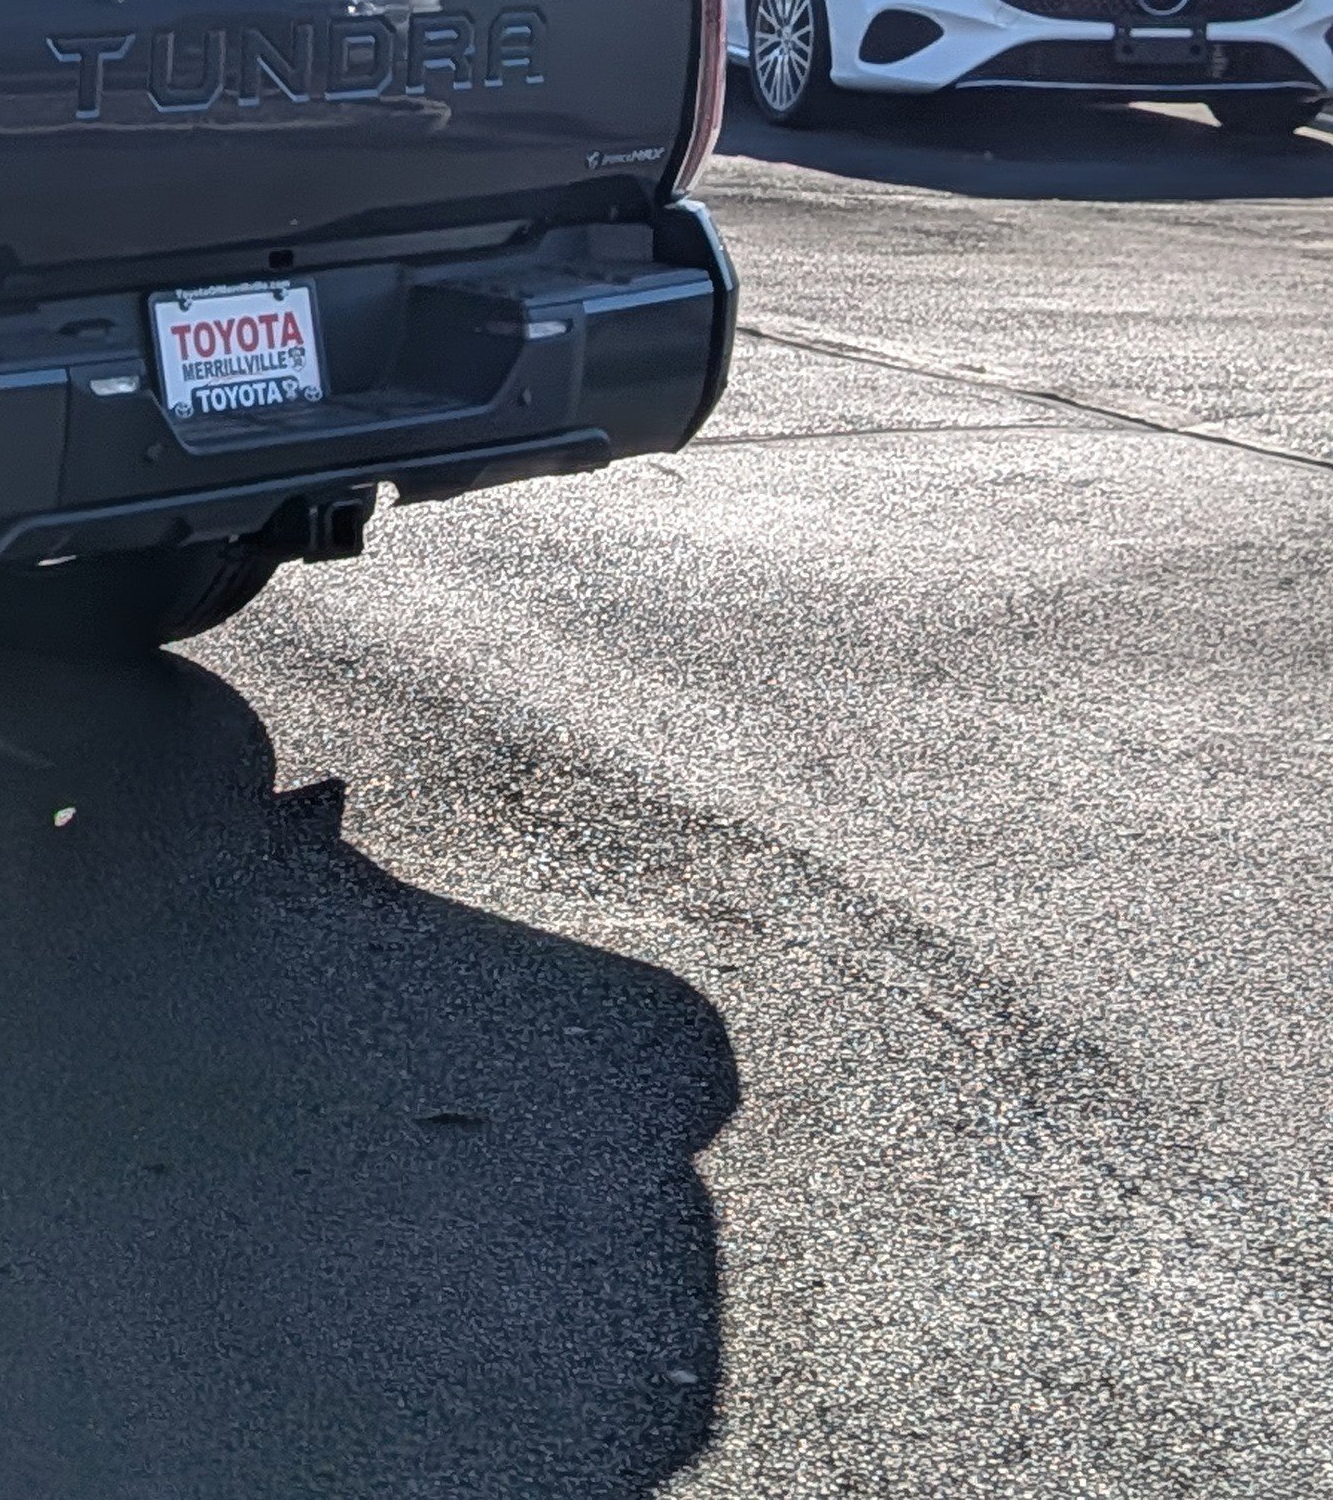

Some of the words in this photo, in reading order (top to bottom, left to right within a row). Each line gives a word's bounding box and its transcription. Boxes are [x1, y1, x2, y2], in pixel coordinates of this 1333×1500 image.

[45, 5, 548, 119] TUNDRA
[170, 311, 304, 361] TOYOTA
[181, 351, 289, 382] MERRILLVILLE
[195, 380, 284, 414] TOYOTA
